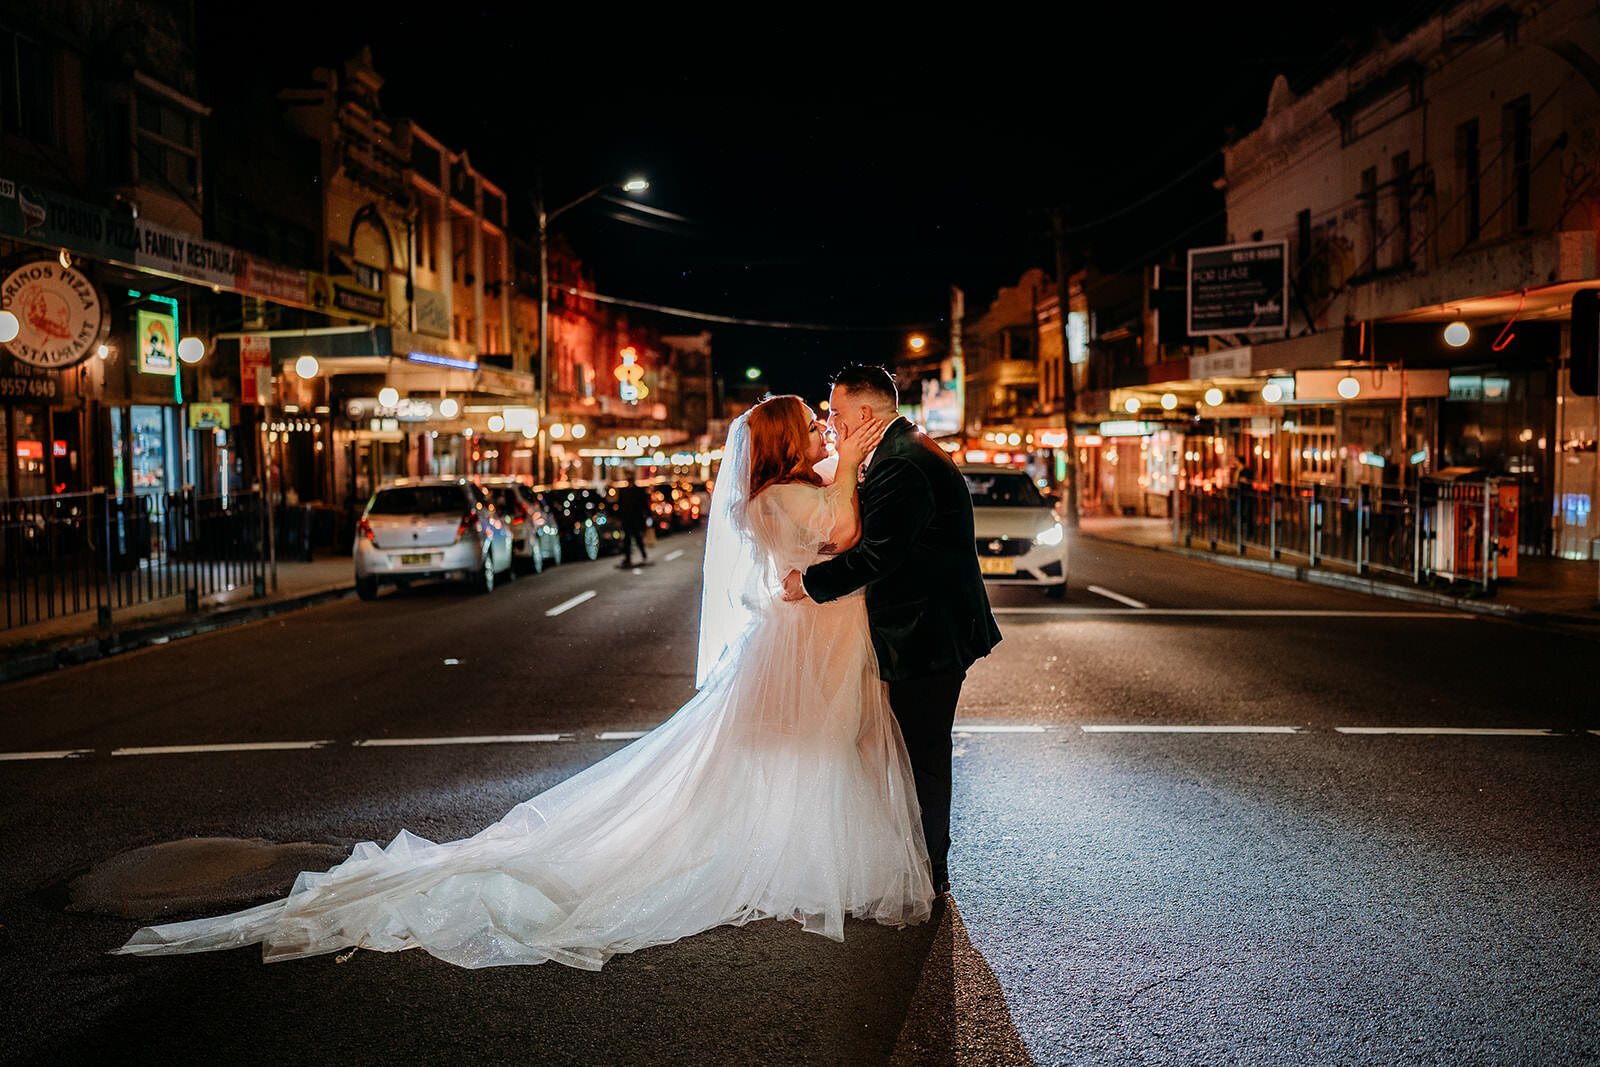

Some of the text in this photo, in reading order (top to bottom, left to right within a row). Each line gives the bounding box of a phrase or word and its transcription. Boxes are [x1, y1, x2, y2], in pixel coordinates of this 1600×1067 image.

[48, 202, 102, 241] TORINO
[106, 219, 142, 253] PIZZA
[145, 230, 184, 262] FAMILY
[1, 267, 94, 311] ORINOS PIZZA
